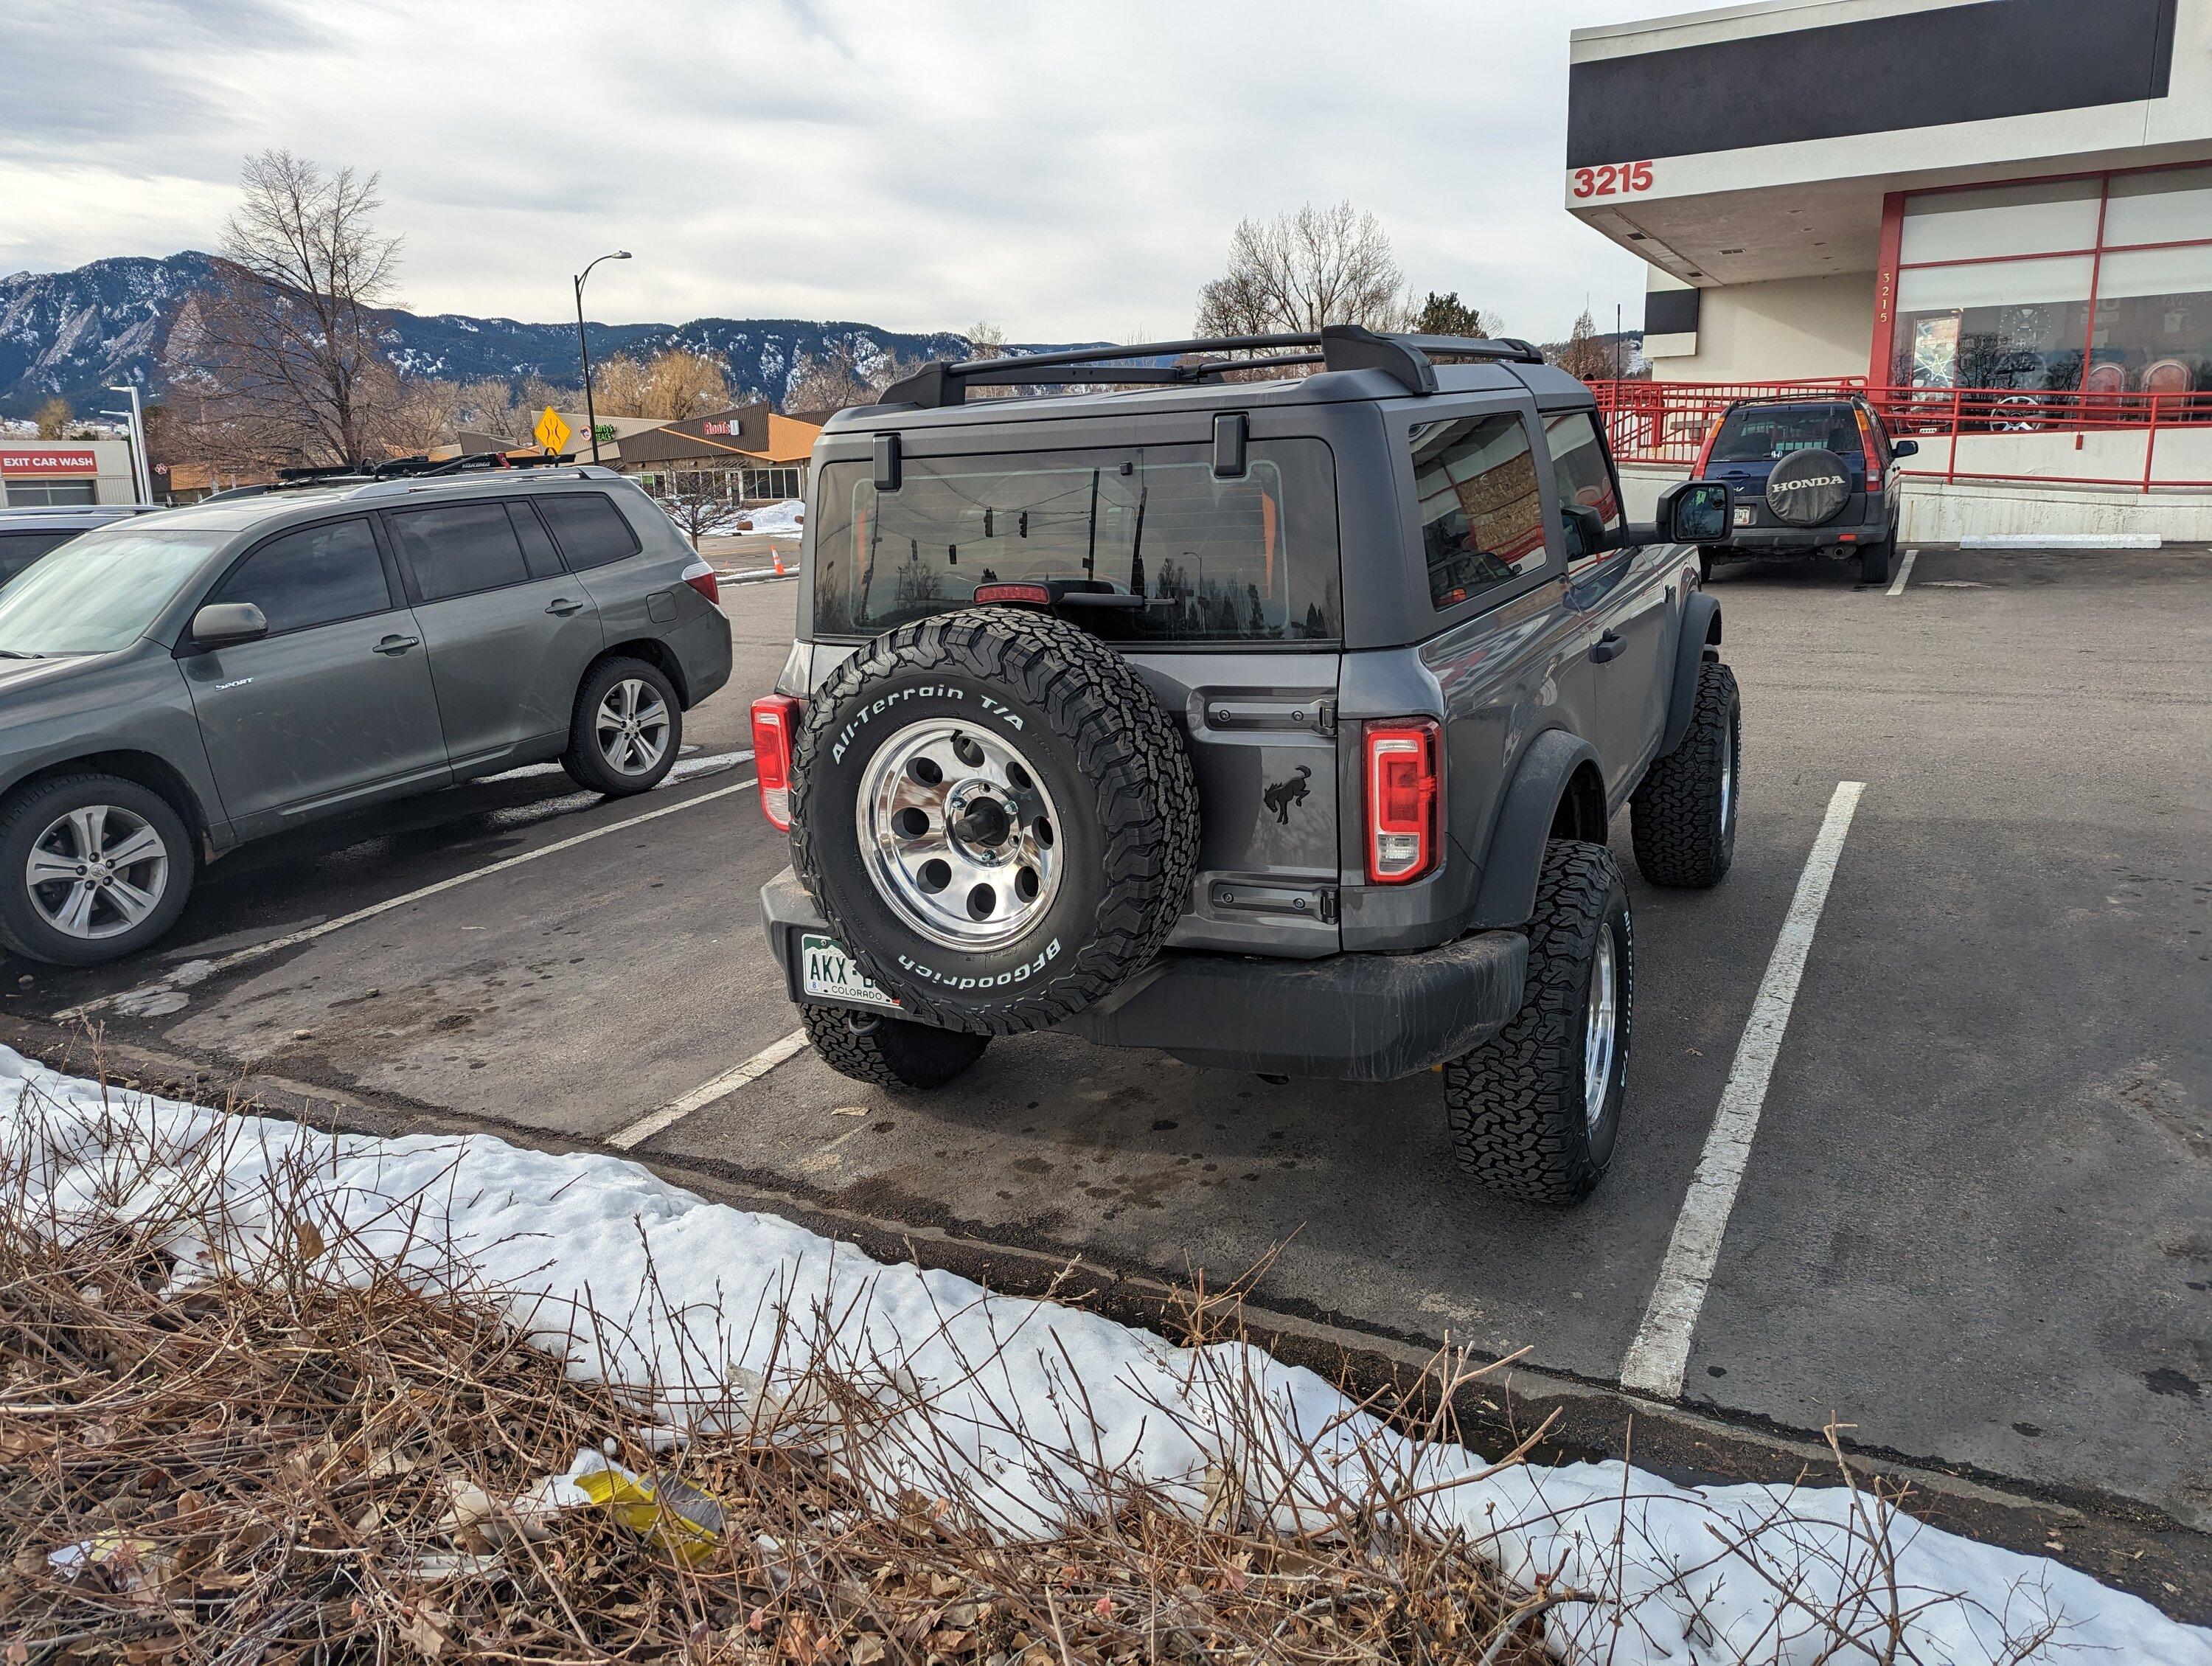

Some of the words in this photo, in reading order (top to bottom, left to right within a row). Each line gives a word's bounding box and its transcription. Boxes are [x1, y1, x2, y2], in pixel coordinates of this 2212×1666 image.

[1573, 161, 1652, 198] 3215
[1880, 273, 1890, 322] 3215
[4, 458, 29, 466] EXIT
[32, 458, 57, 466] CAR
[59, 458, 93, 466] WASH
[1772, 476, 1845, 493] HONDA
[215, 678, 253, 692] SPORT
[832, 684, 963, 764] All-Terrain
[981, 695, 1023, 731] T/A
[898, 937, 1062, 990] BFGoodrich
[831, 985, 883, 1000] COLORADO
